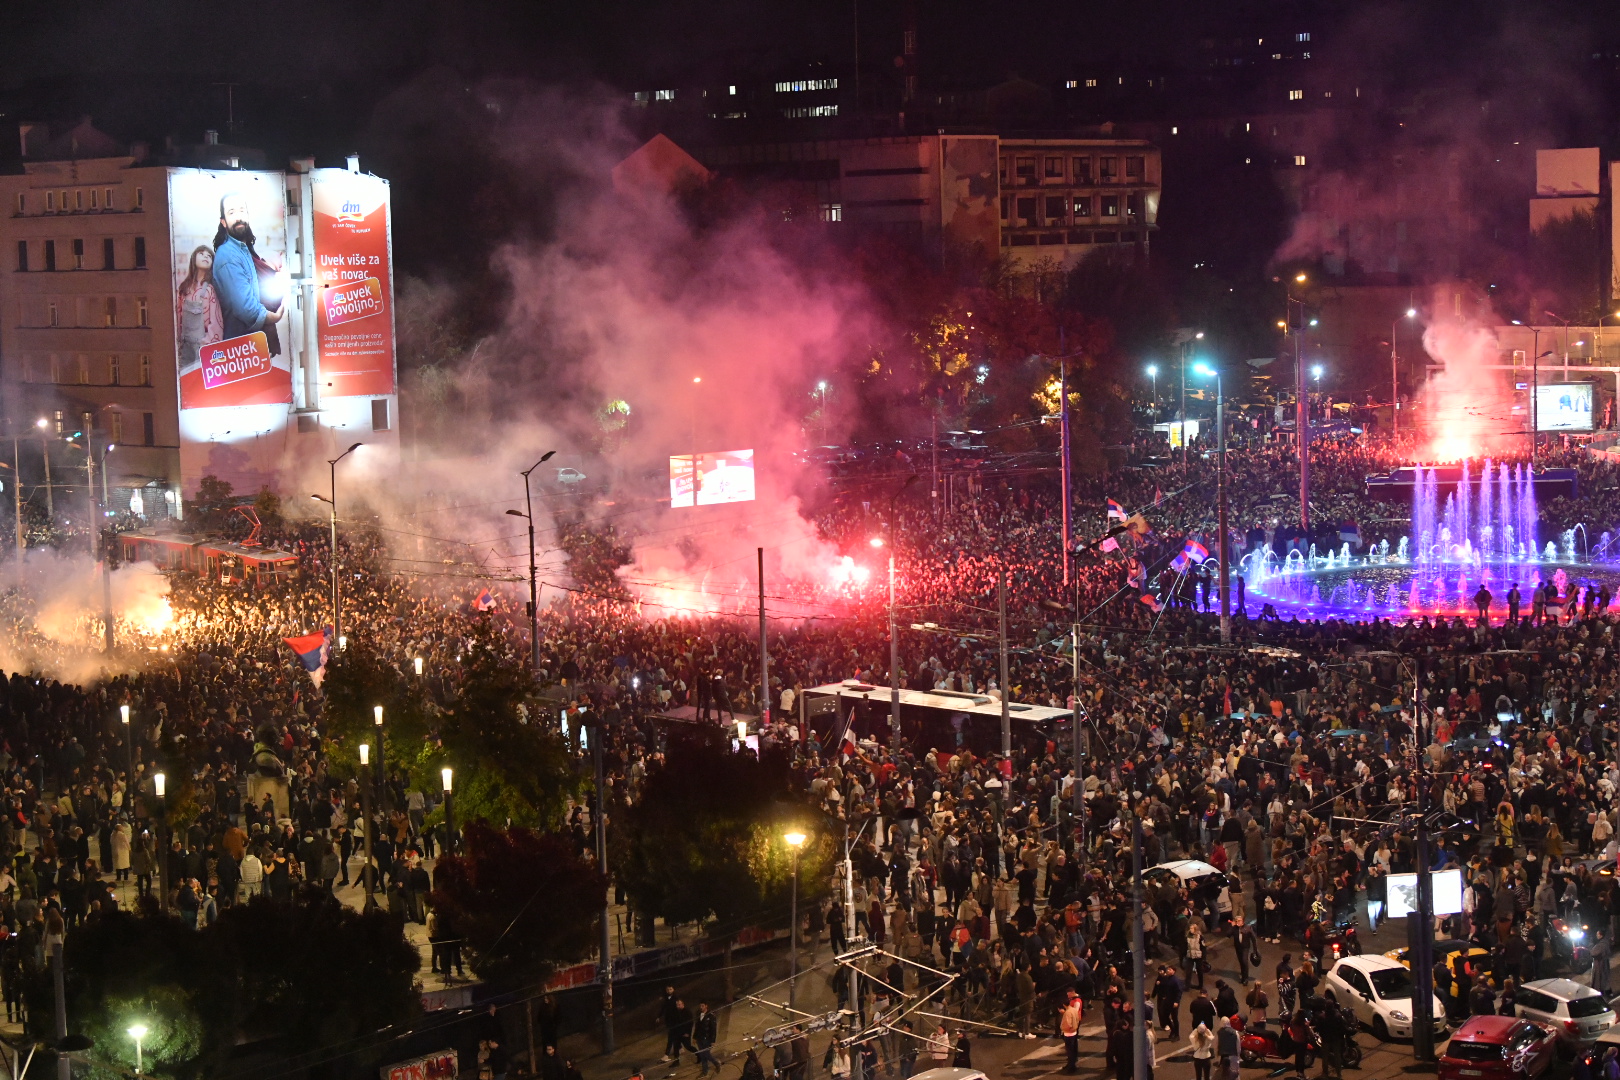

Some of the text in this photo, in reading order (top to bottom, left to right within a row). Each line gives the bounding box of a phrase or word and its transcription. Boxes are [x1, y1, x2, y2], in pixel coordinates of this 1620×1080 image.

[342, 200, 360, 213] dm
[321, 254, 380, 266] Uvek više za
[322, 268, 338, 280] vaš
[346, 285, 372, 301] uvek
[329, 298, 380, 321] povoljno,-
[213, 341, 258, 359] dm uvek
[206, 356, 267, 383] povoljno,-
